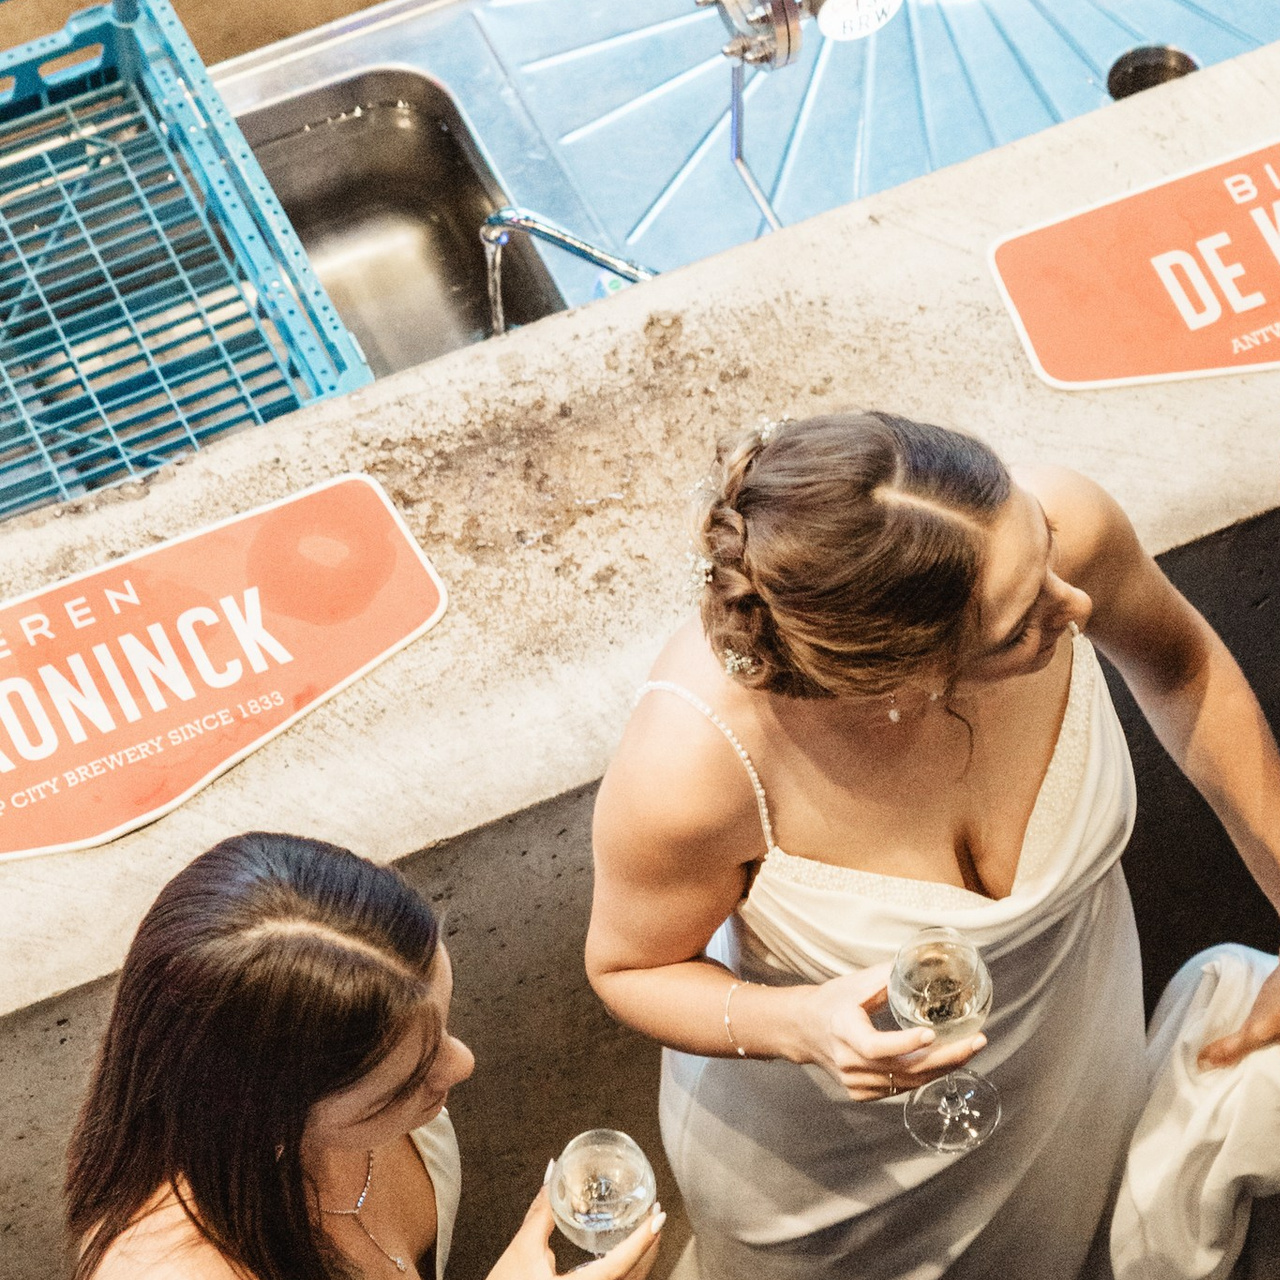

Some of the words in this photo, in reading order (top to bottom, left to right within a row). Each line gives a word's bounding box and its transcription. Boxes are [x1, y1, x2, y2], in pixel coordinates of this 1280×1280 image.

[1150, 231, 1266, 331] DE
[0, 586, 294, 773] ONINCK
[11, 777, 61, 808] CITY
[62, 736, 164, 788] BREWERY
[167, 708, 235, 746] SINCE
[236, 690, 285, 719] 1833
